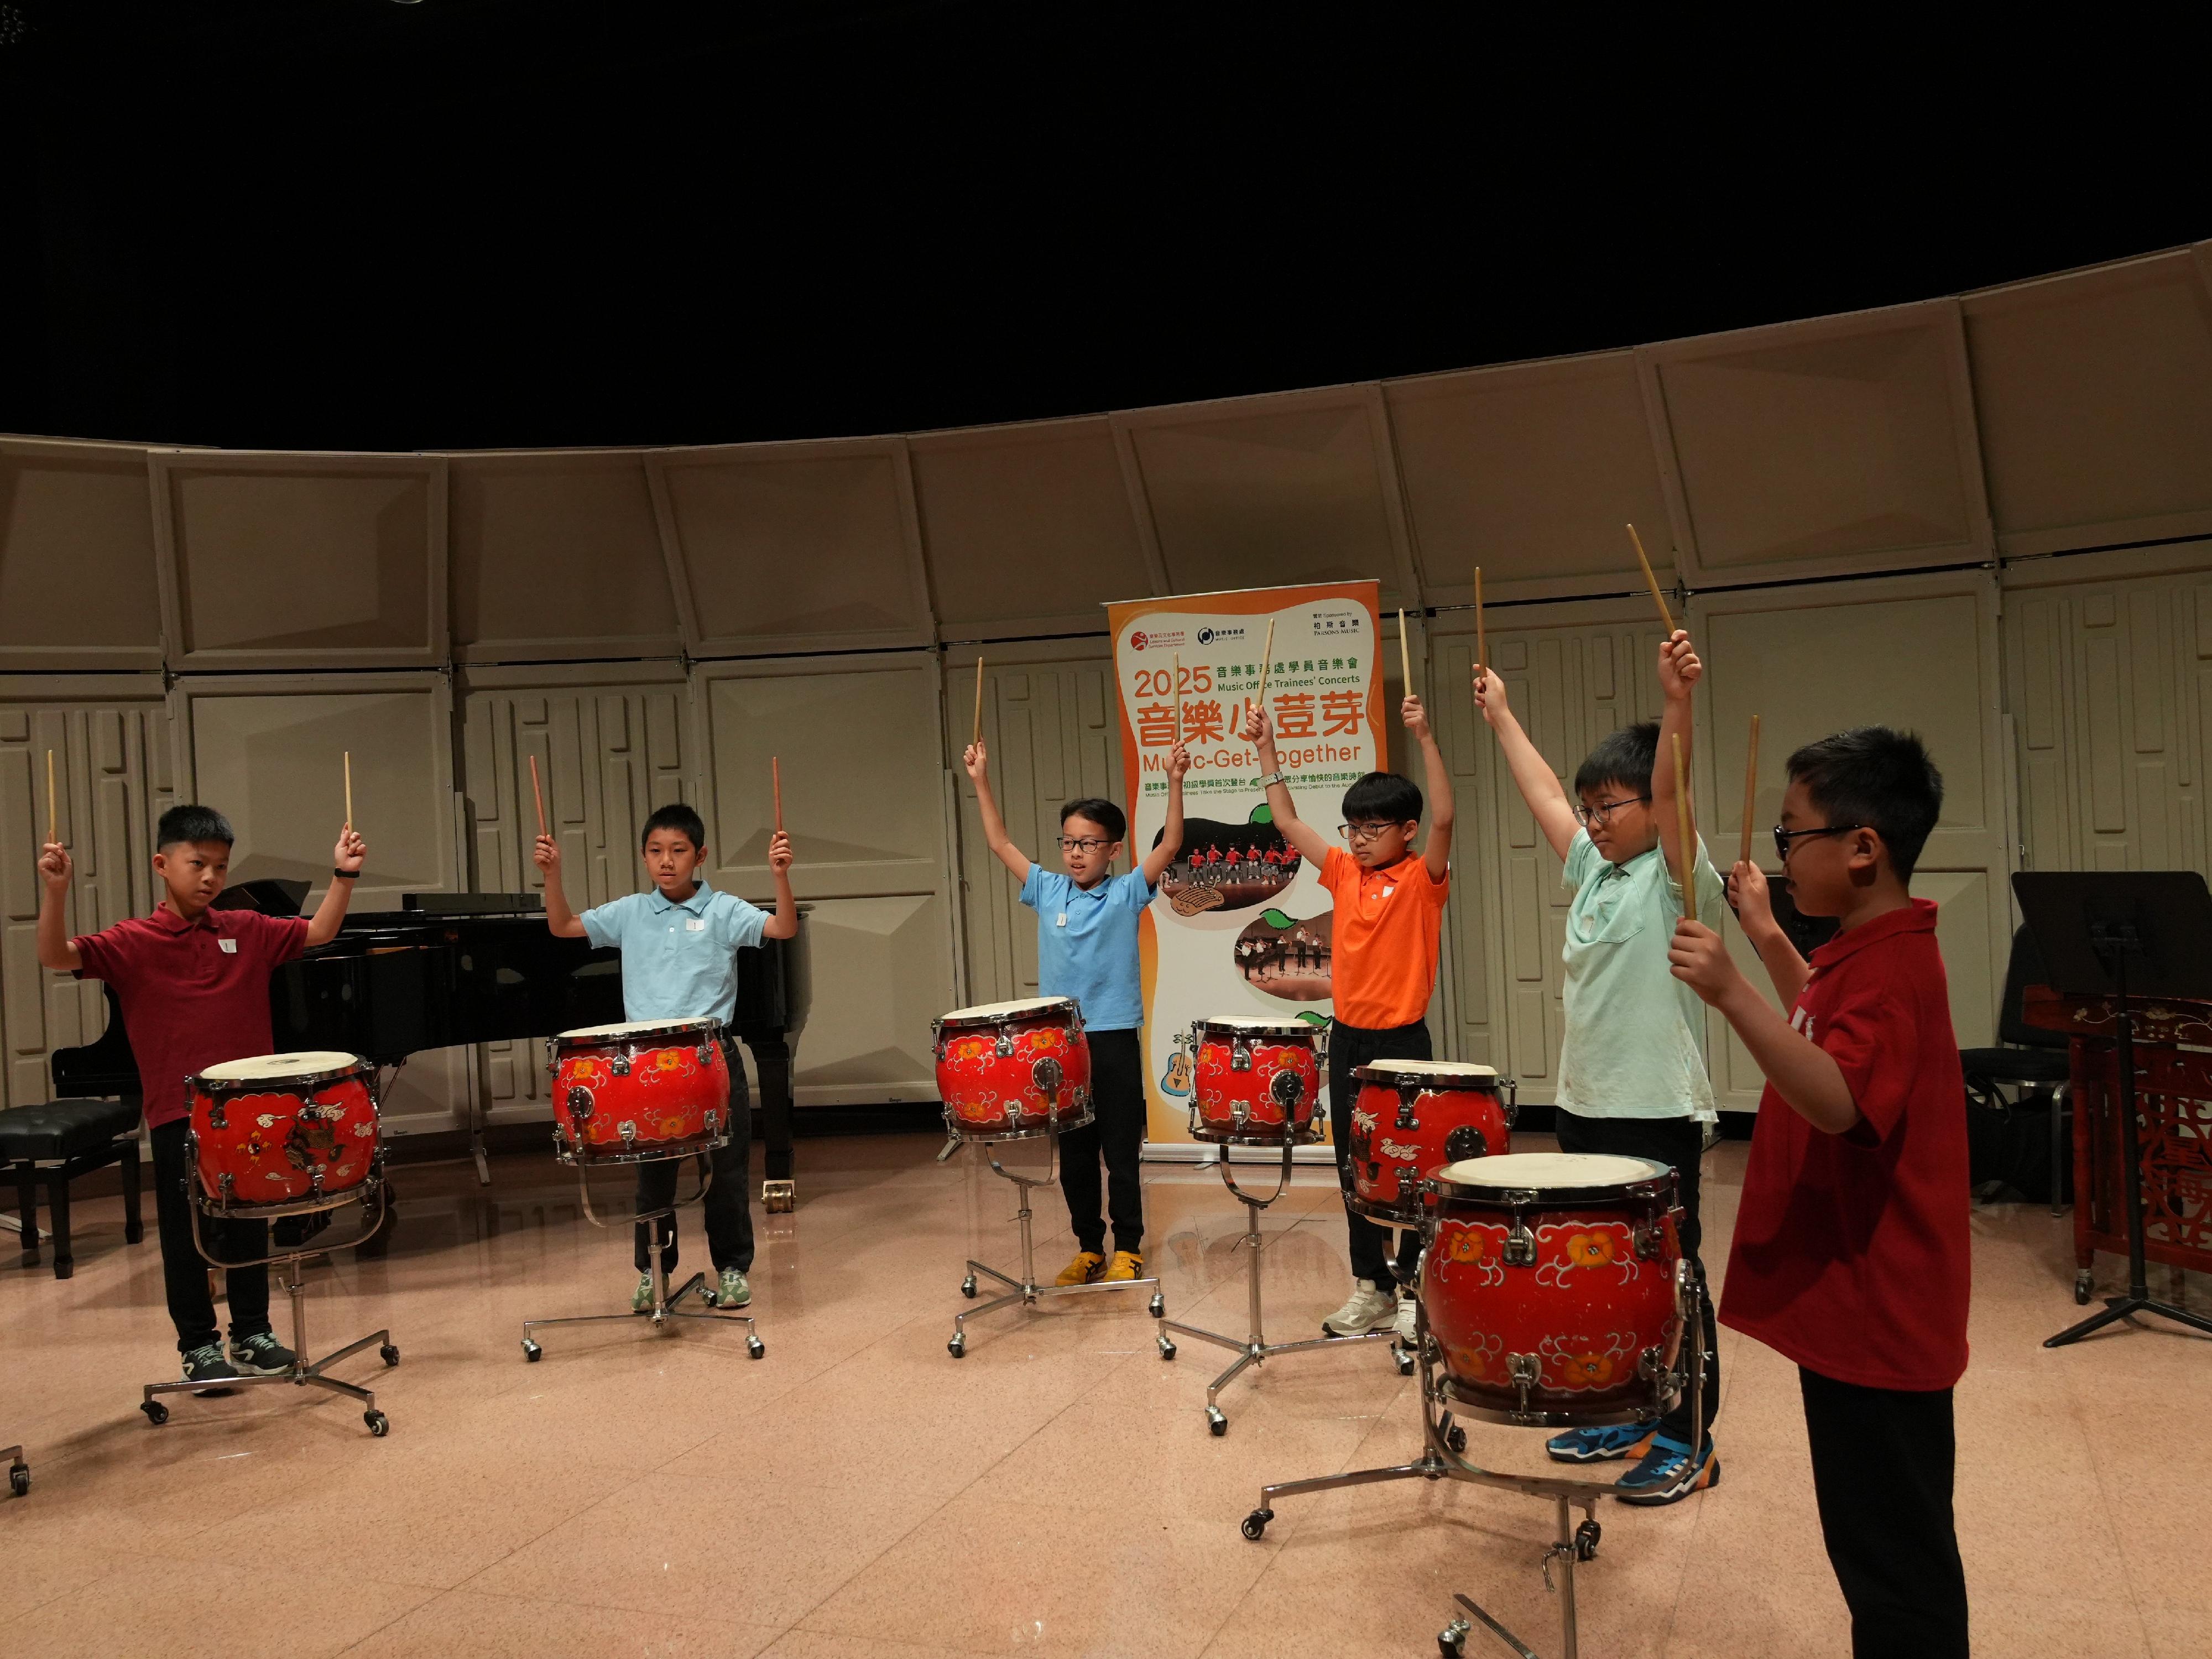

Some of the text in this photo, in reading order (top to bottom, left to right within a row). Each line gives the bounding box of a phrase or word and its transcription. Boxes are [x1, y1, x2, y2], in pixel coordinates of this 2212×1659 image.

[1314, 619, 1359, 629] 柏斯音樂
[1134, 666, 1212, 698] 2025
[1218, 682, 1244, 691] Music
[1246, 681, 1272, 690] Offe
[1318, 675, 1360, 685] Concerts
